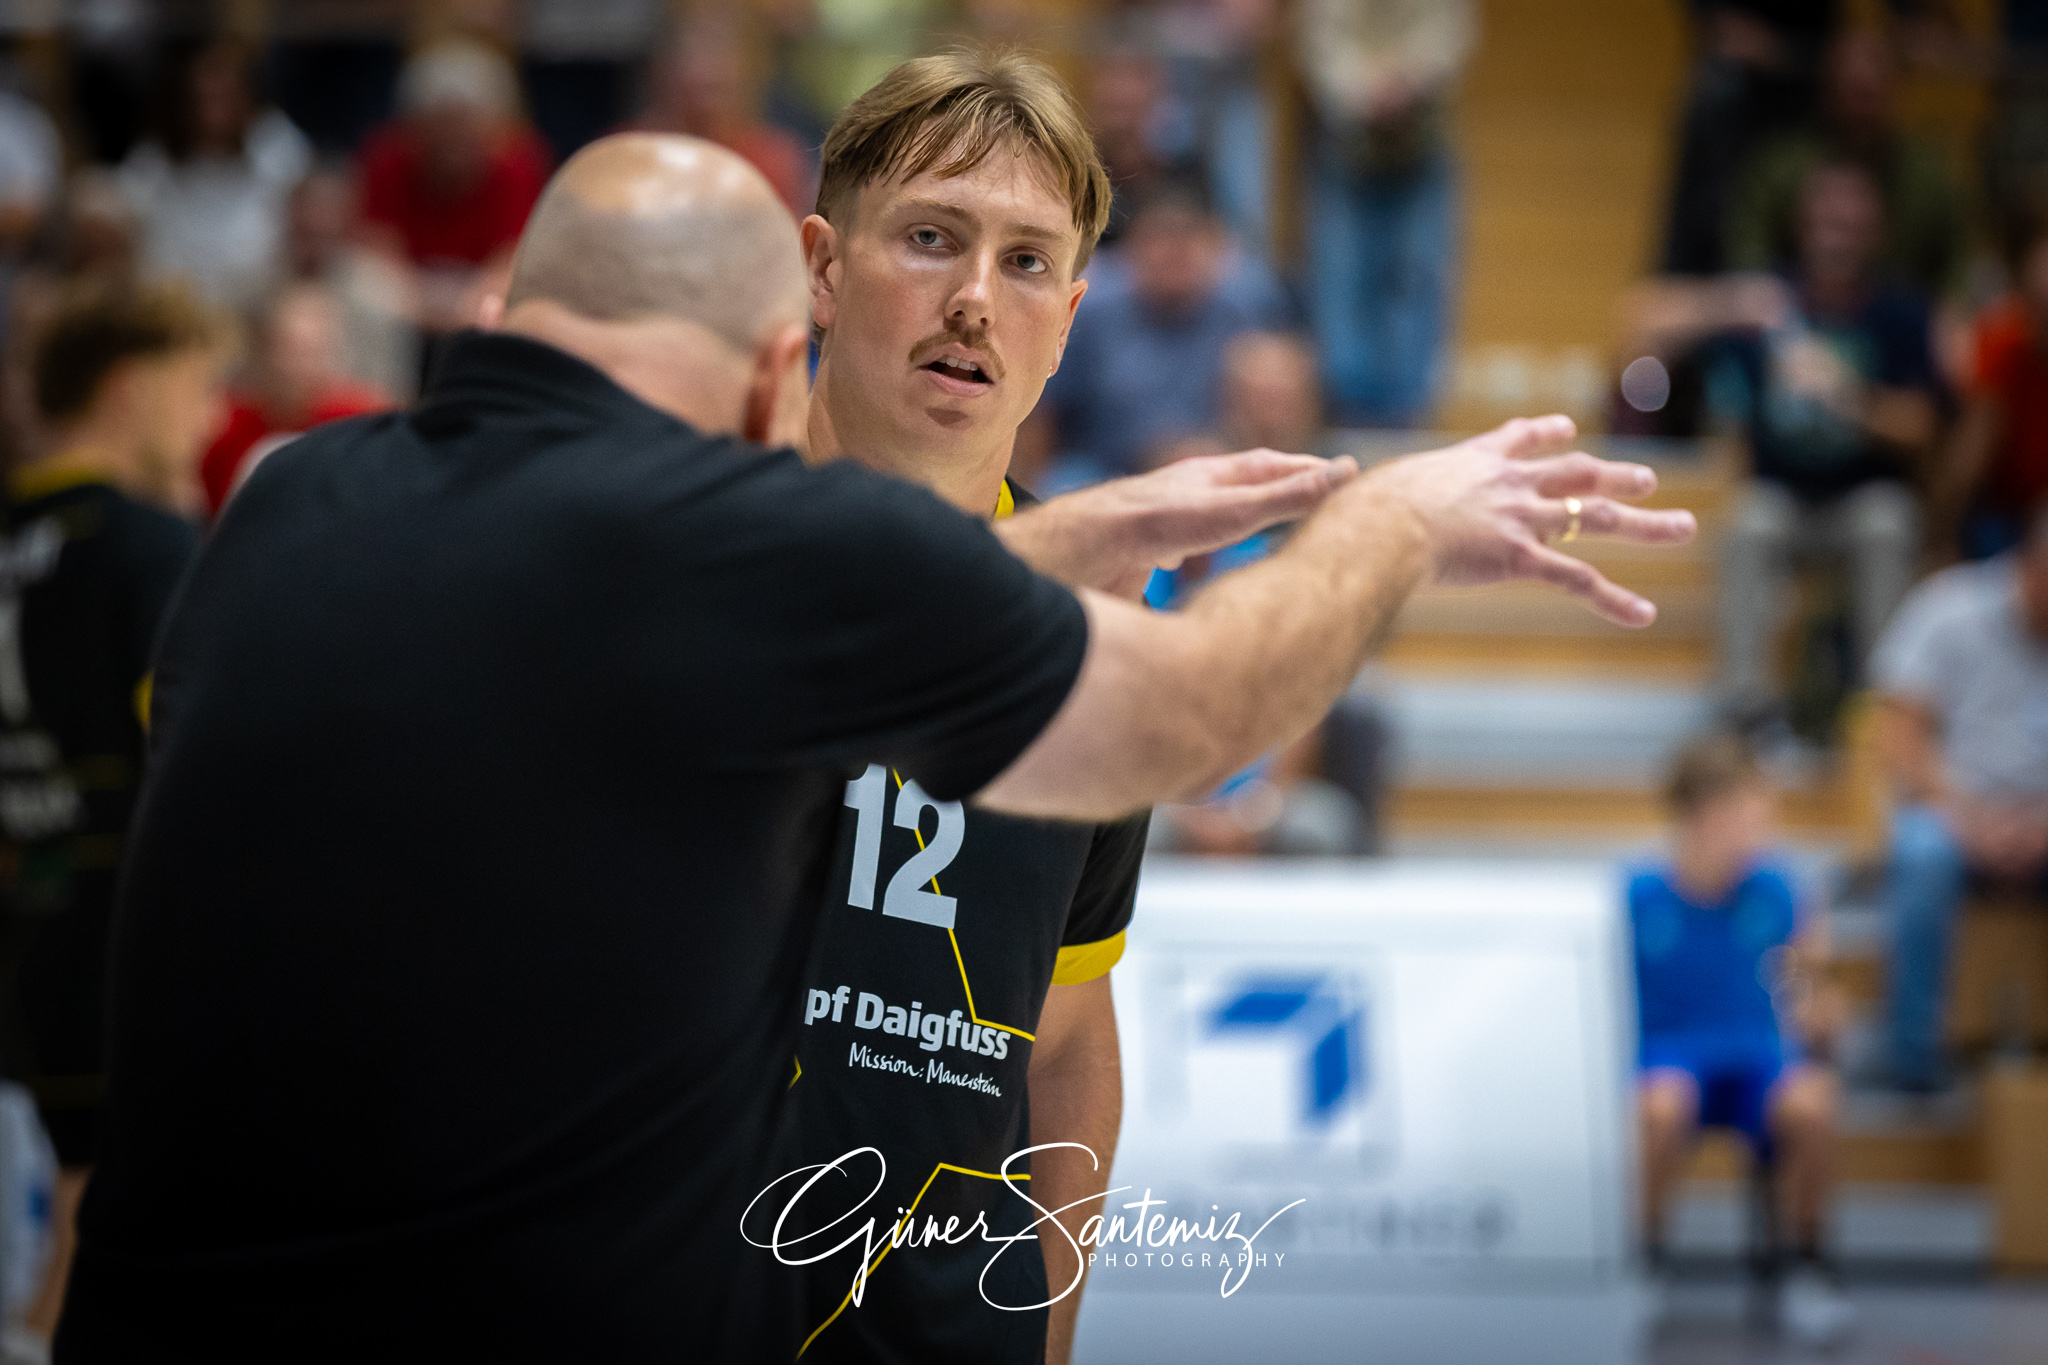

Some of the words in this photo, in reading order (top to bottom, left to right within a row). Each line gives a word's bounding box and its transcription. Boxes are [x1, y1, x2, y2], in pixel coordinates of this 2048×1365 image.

[844, 763, 966, 929] 12
[849, 1042, 924, 1078] Mission:
[854, 992, 1011, 1060] Daigfuss
